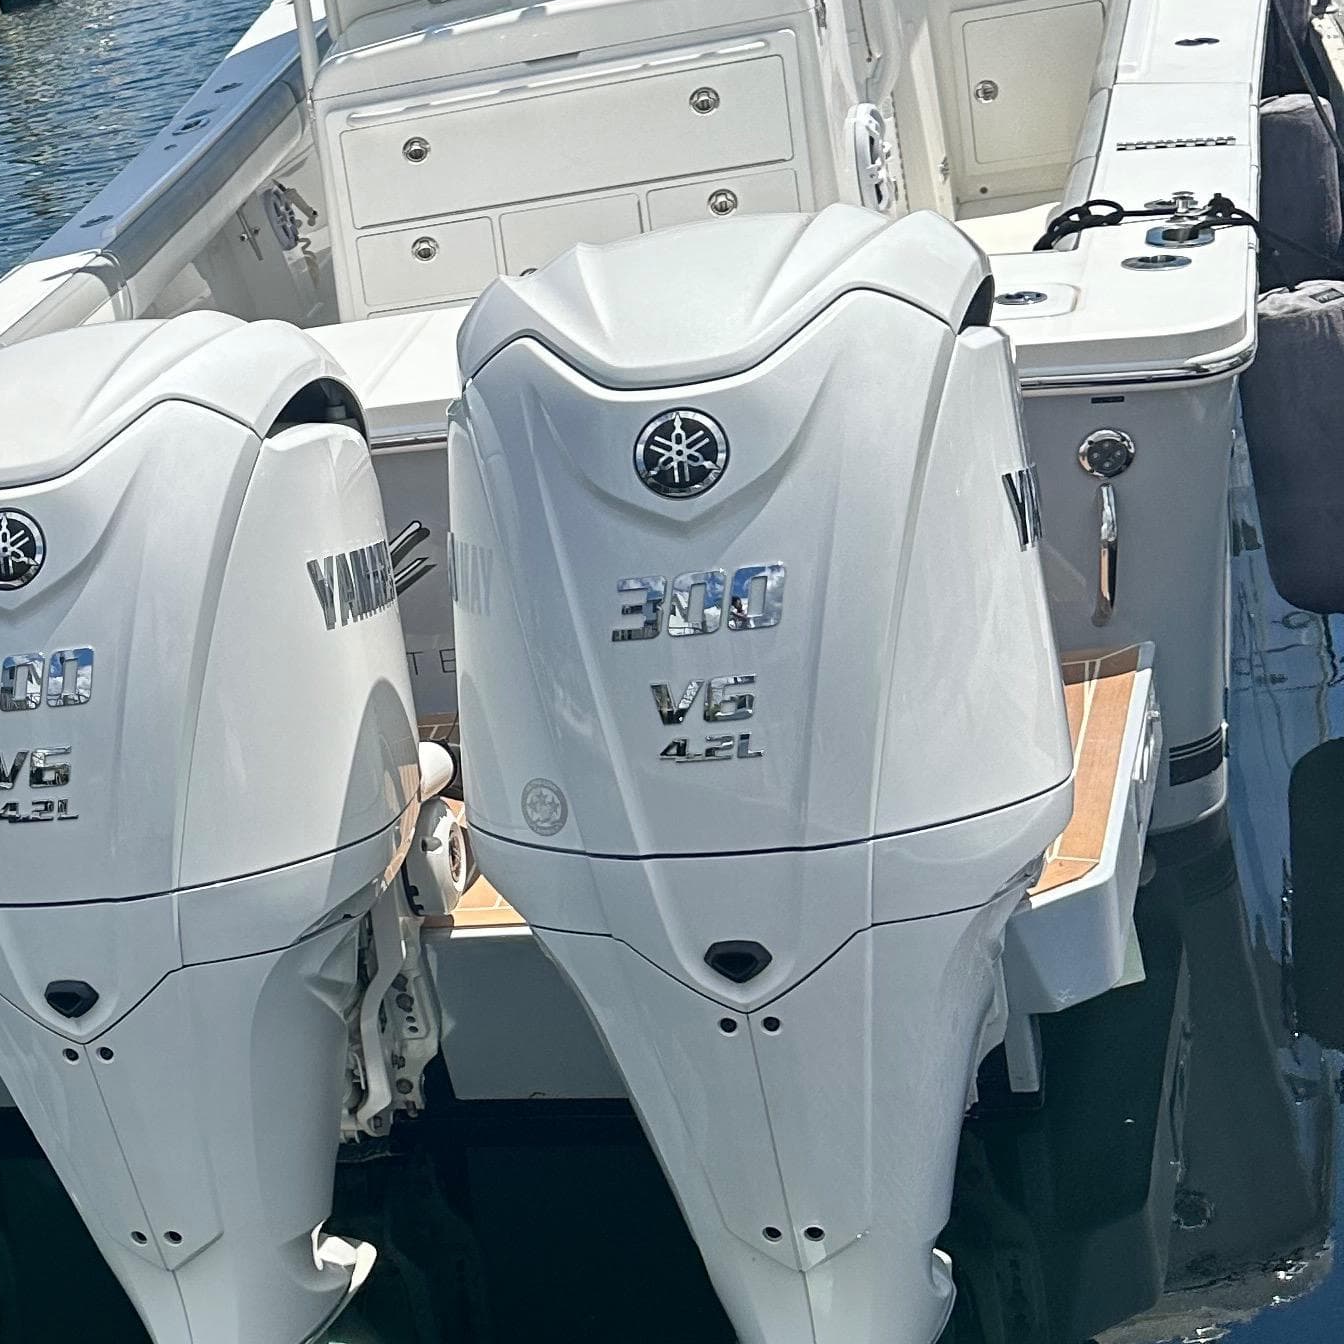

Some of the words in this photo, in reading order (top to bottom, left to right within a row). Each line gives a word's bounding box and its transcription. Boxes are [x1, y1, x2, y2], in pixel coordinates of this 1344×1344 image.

[612, 560, 787, 642] 300
[650, 673, 757, 725] V6
[659, 731, 765, 763] 4.2L
